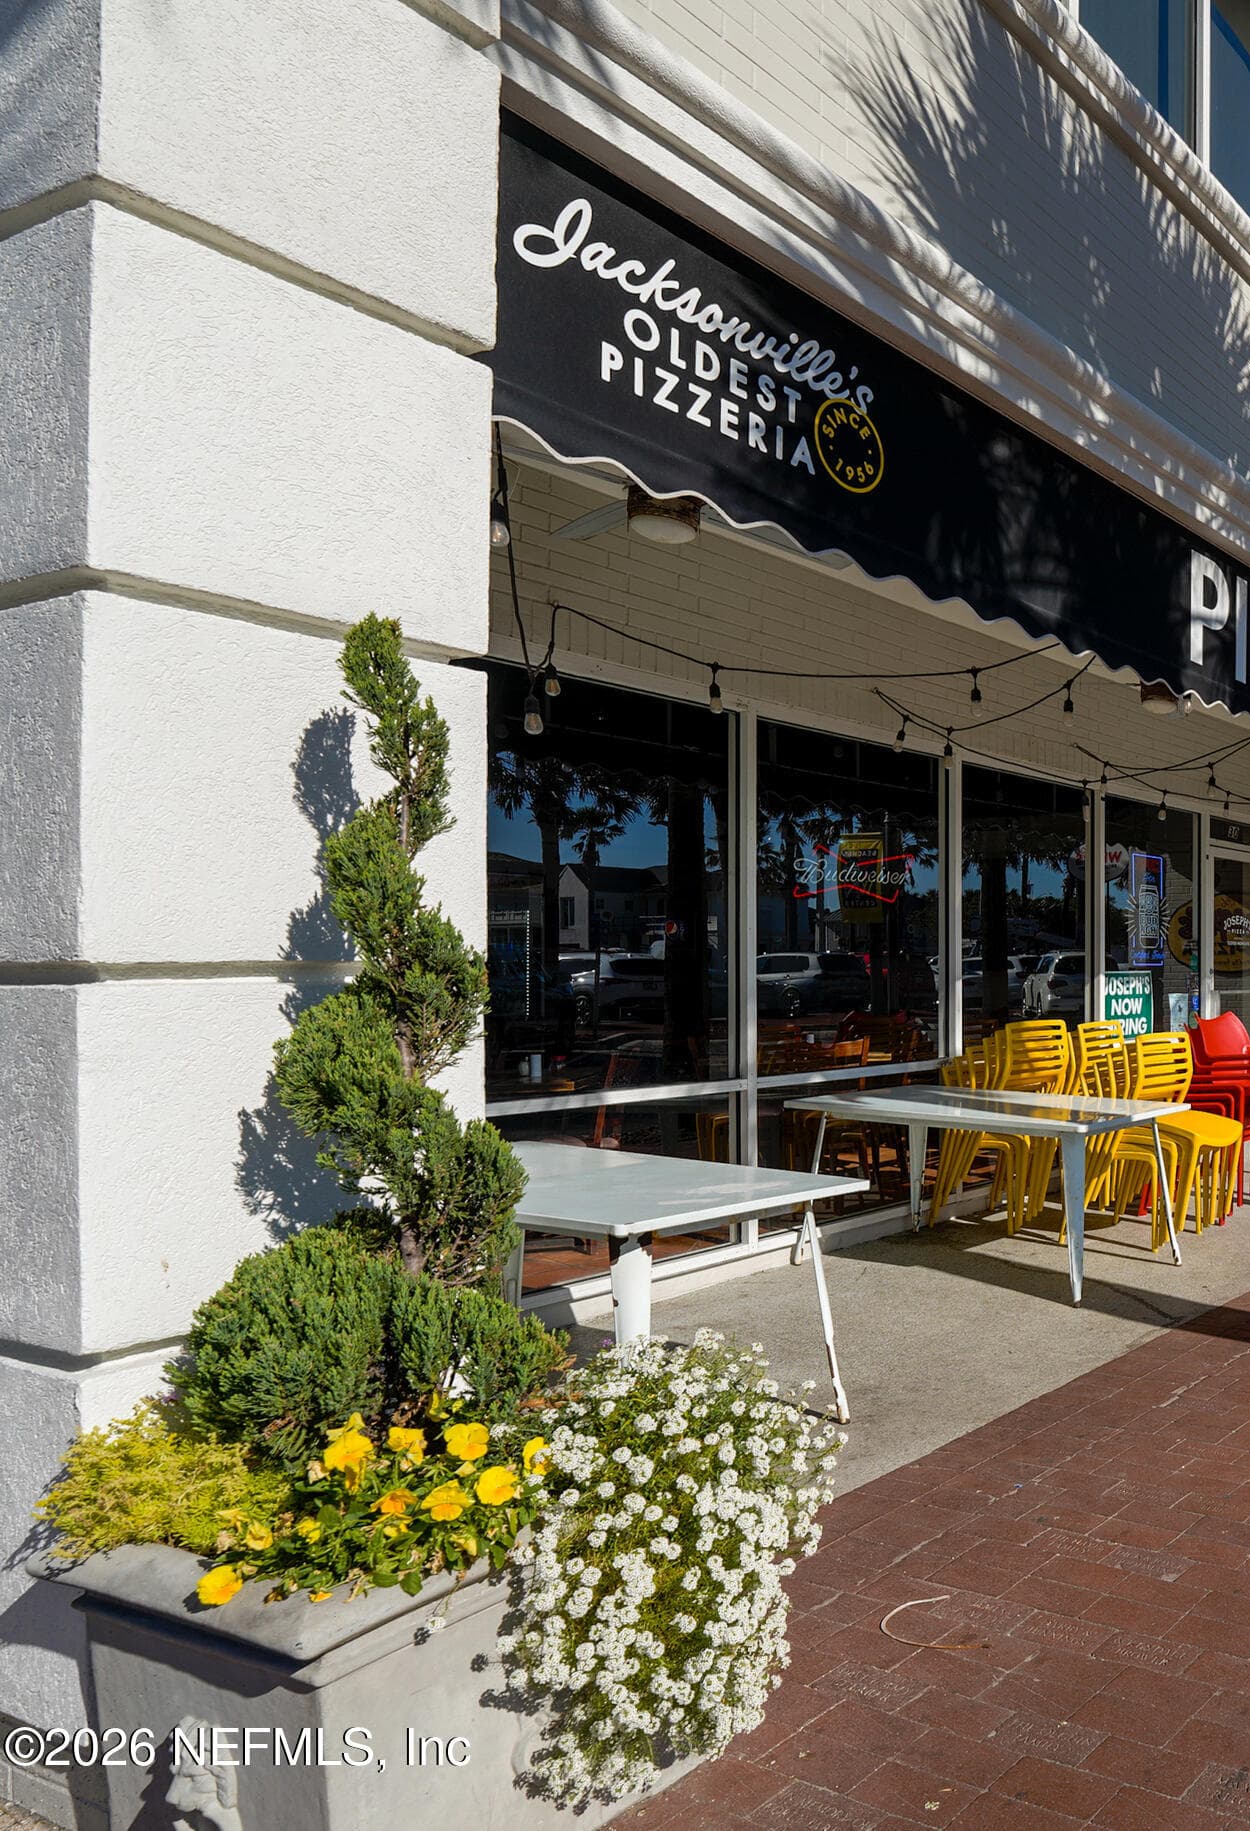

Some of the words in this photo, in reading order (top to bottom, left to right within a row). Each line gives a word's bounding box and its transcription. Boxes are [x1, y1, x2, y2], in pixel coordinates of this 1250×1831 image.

[513, 198, 874, 415] Jacksonville's
[623, 309, 802, 423] OLDEST
[601, 341, 815, 475] PIZZERIA
[822, 407, 871, 440] SINCE
[835, 458, 874, 482] 1956
[793, 858, 907, 885] Budweiser
[1111, 997, 1143, 1016] NOW
